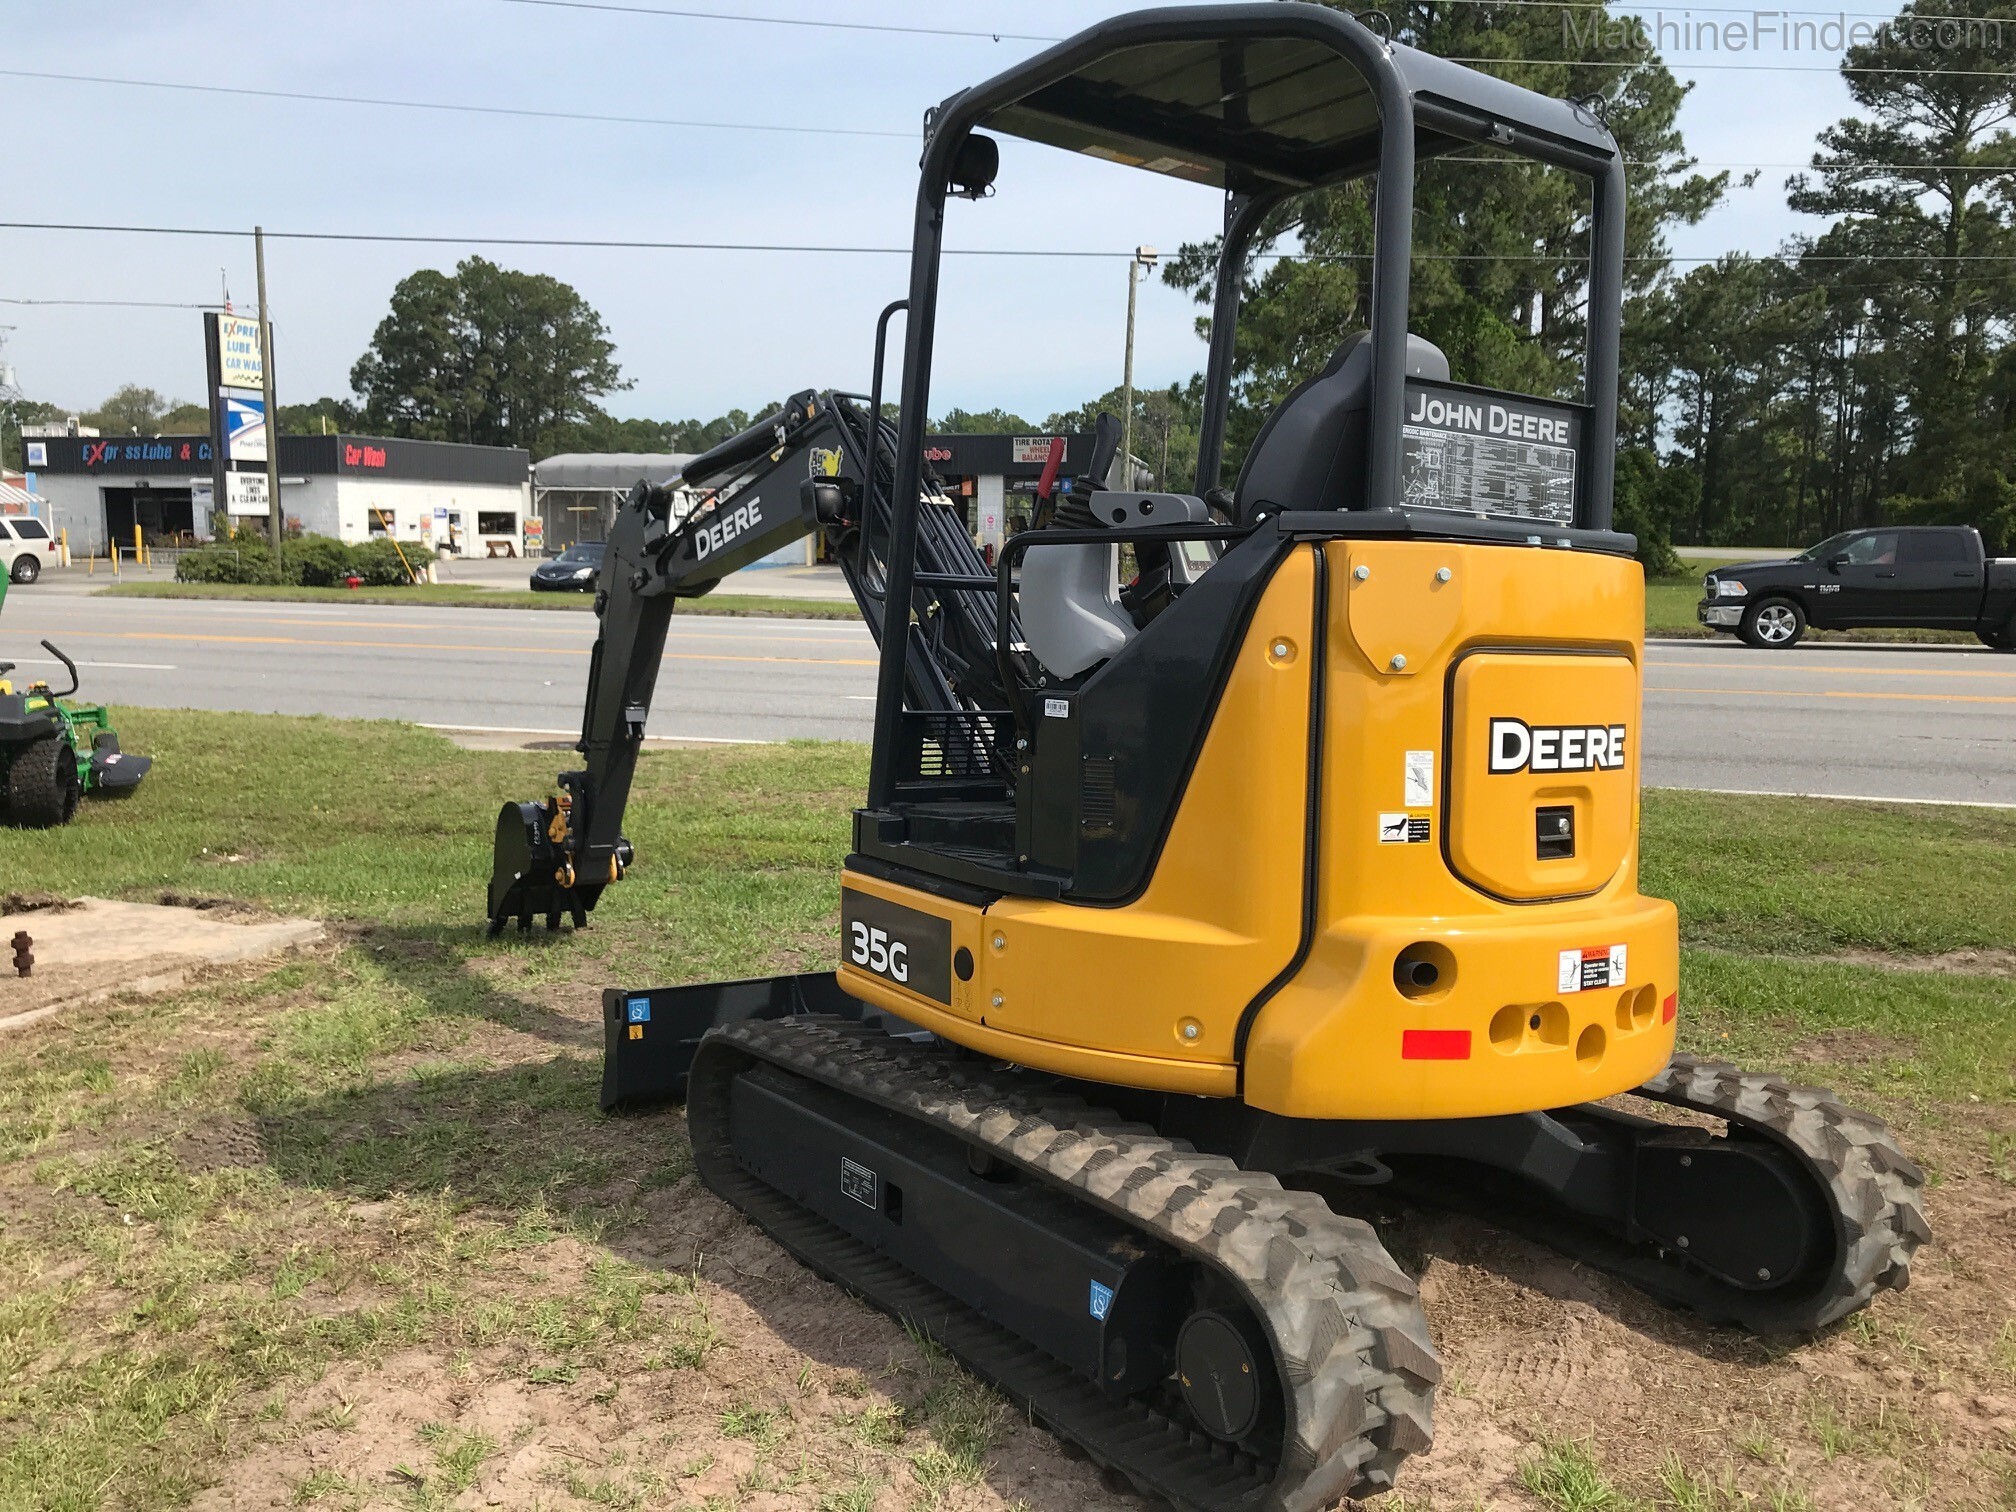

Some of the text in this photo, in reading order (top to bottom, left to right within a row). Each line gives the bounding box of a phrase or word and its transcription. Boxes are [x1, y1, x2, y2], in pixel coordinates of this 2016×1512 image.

[227, 341, 251, 354] LUBE
[226, 357, 262, 372] CAR WAS
[1410, 393, 1569, 444] JOHN DEERE
[1403, 427, 1419, 436] ERIODIC
[1015, 438, 1030, 446] TIRE
[180, 442, 191, 461] &
[345, 444, 387, 468] Car Wash
[923, 447, 952, 461] ube
[1021, 453, 1049, 462] BALANC
[240, 476, 266, 486] EVERYONE
[239, 494, 257, 504] CLEAN
[694, 496, 763, 561] DEERE
[1490, 720, 1626, 771] DEERE
[851, 921, 908, 982] 35G
[1594, 978, 1607, 986] CLEAR
